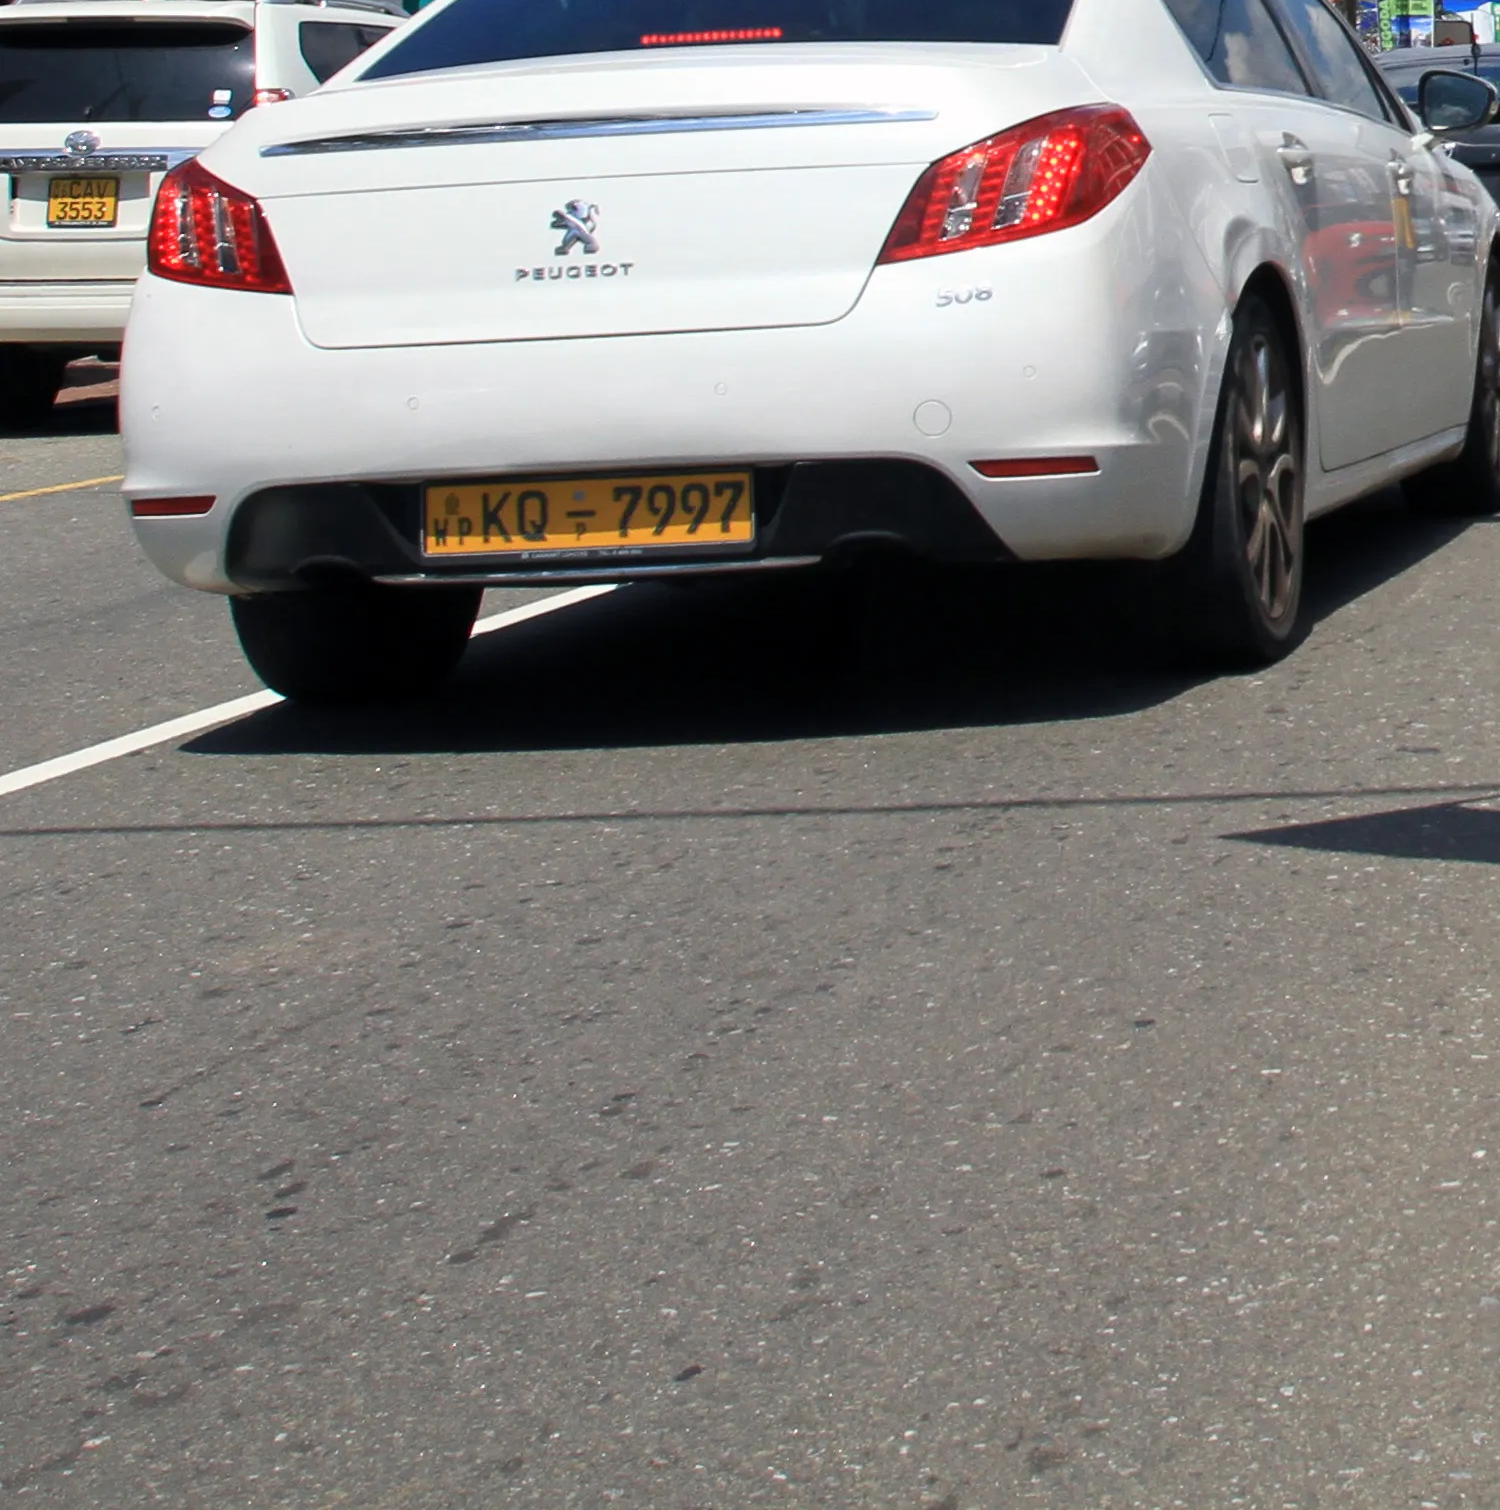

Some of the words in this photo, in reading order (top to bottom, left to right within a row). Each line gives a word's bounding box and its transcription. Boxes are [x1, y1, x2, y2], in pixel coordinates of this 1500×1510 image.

[69, 180, 109, 199] CAV
[56, 201, 108, 220] 3553
[515, 262, 634, 282] PEUGEOT
[934, 281, 993, 308] 508
[481, 489, 549, 544] KQ
[611, 481, 746, 538] 7997
